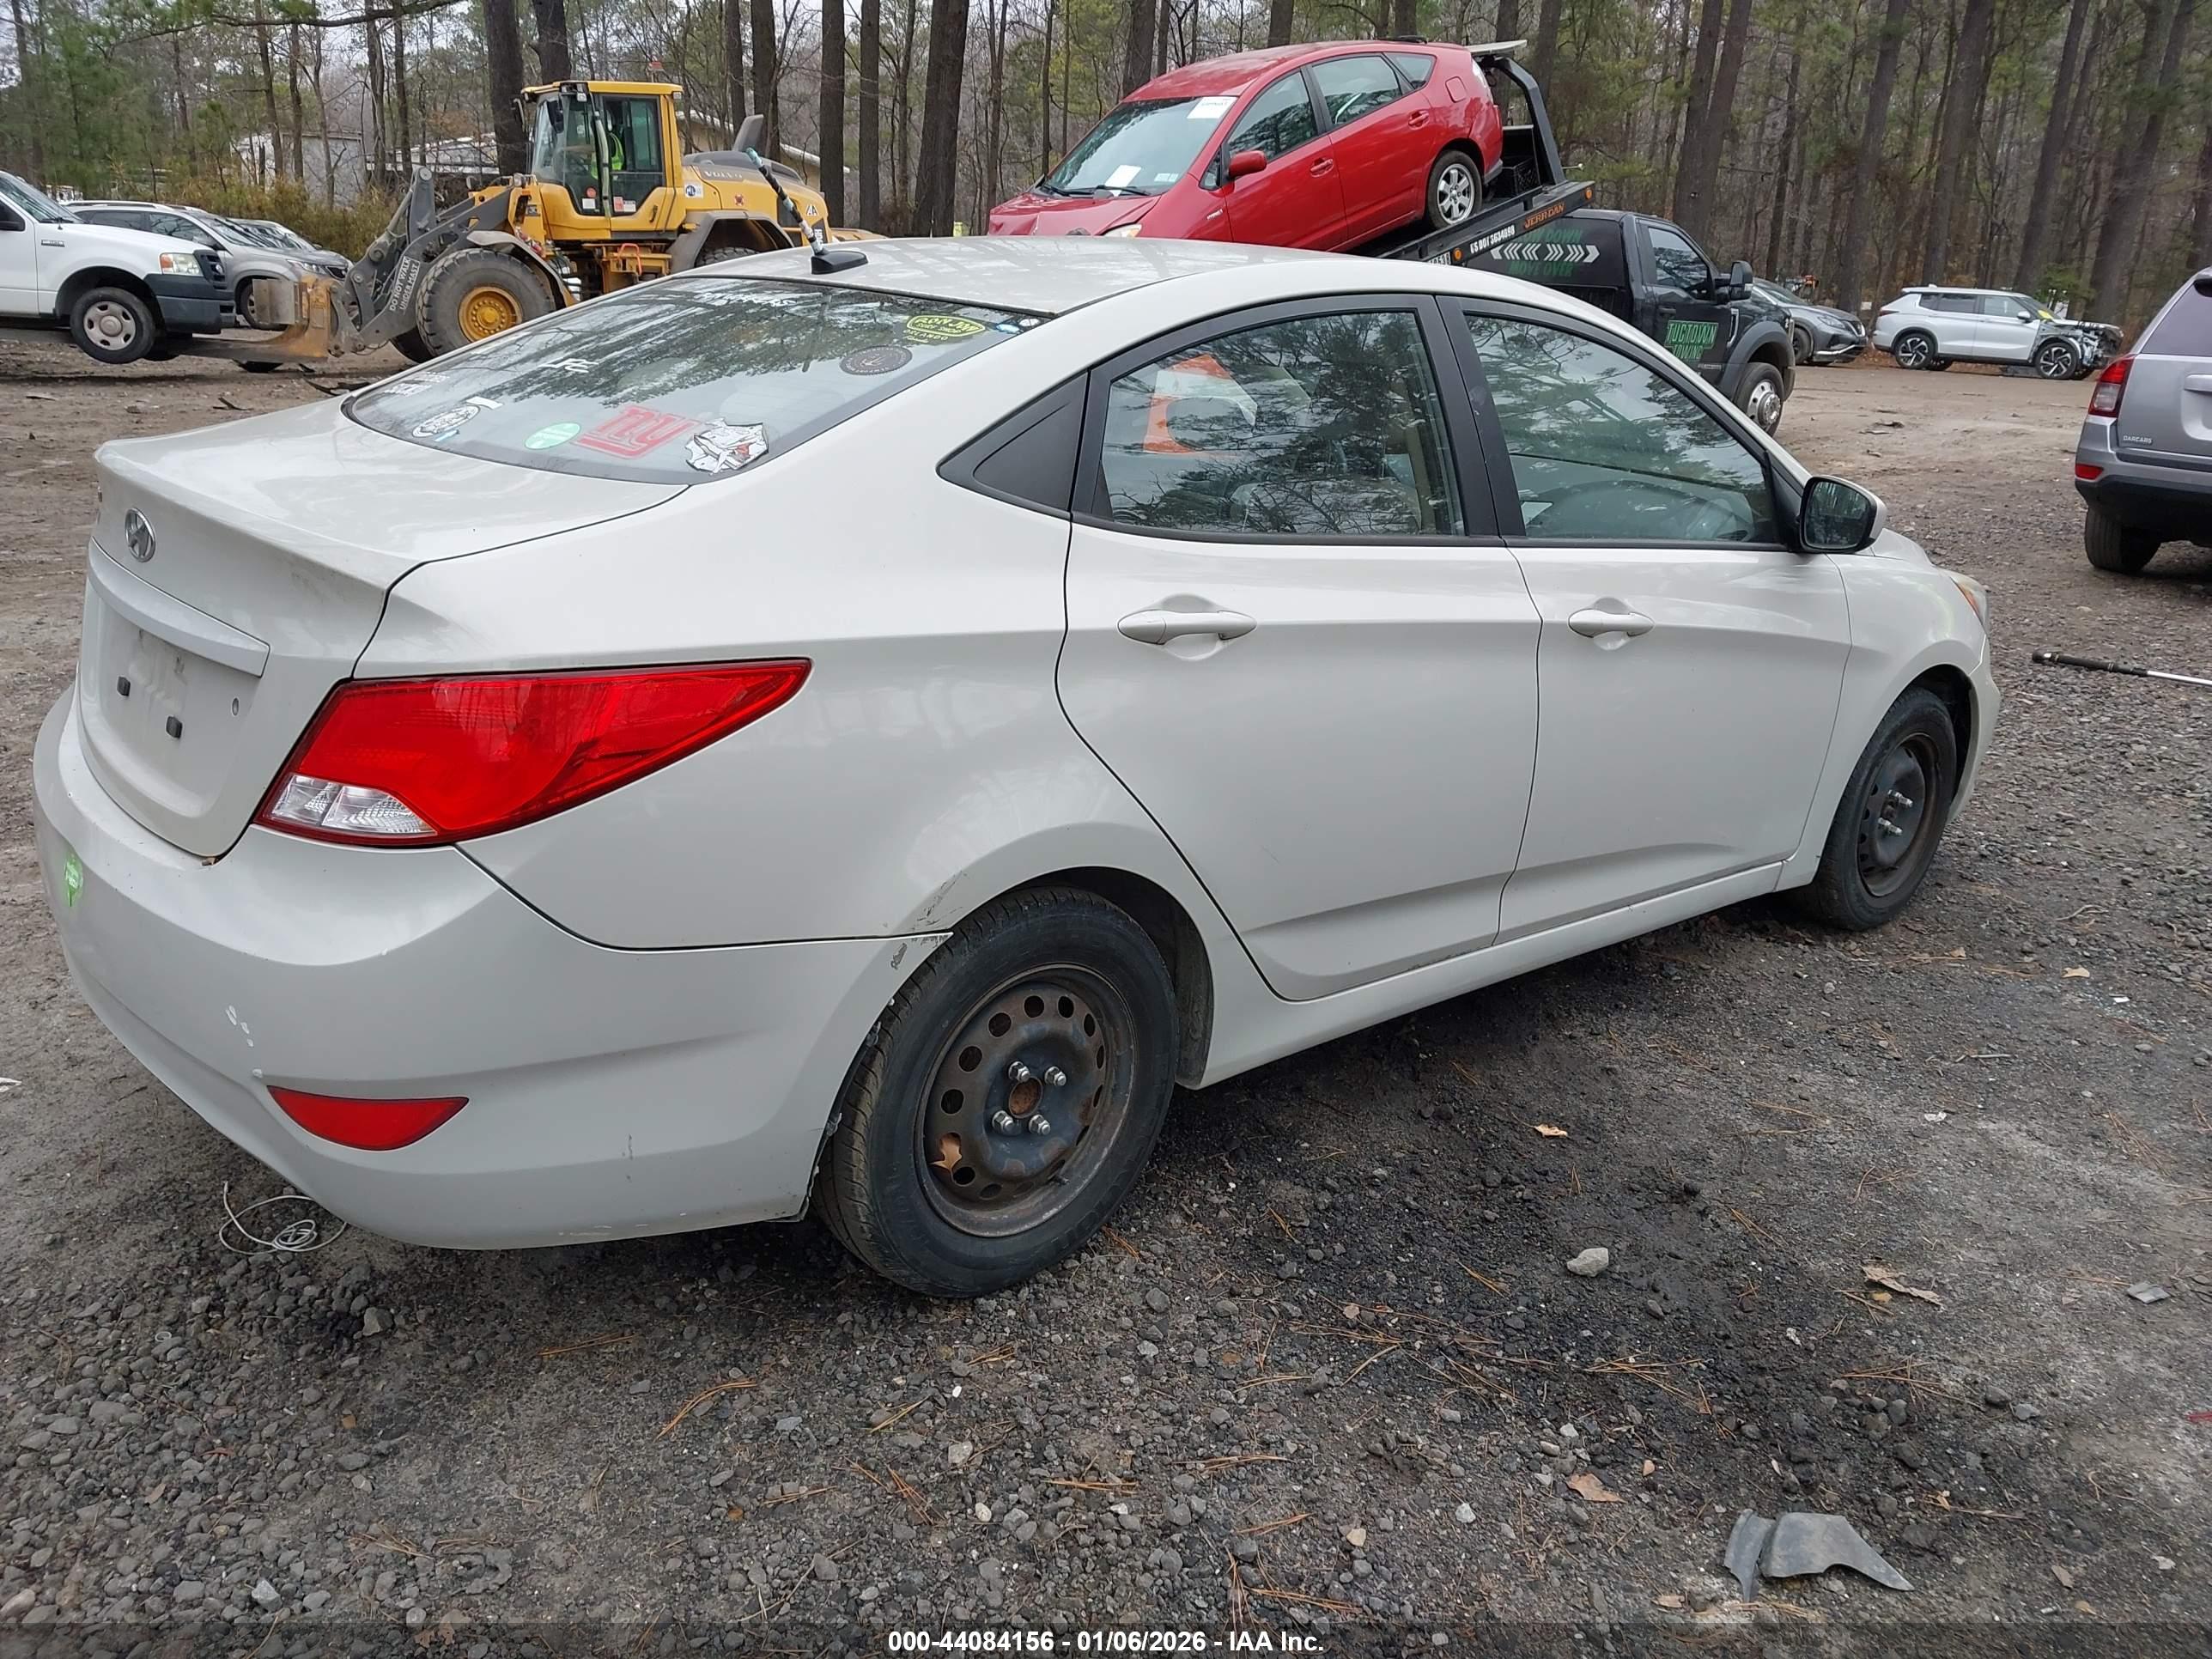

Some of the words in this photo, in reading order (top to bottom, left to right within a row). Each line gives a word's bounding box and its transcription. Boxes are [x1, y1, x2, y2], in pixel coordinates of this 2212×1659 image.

[1479, 236, 1490, 251] DOT
[399, 258, 410, 280] WALK
[407, 263, 418, 284] MAST
[1543, 261, 1575, 276] OVER
[395, 283, 404, 297] NOT
[390, 299, 398, 311] DO
